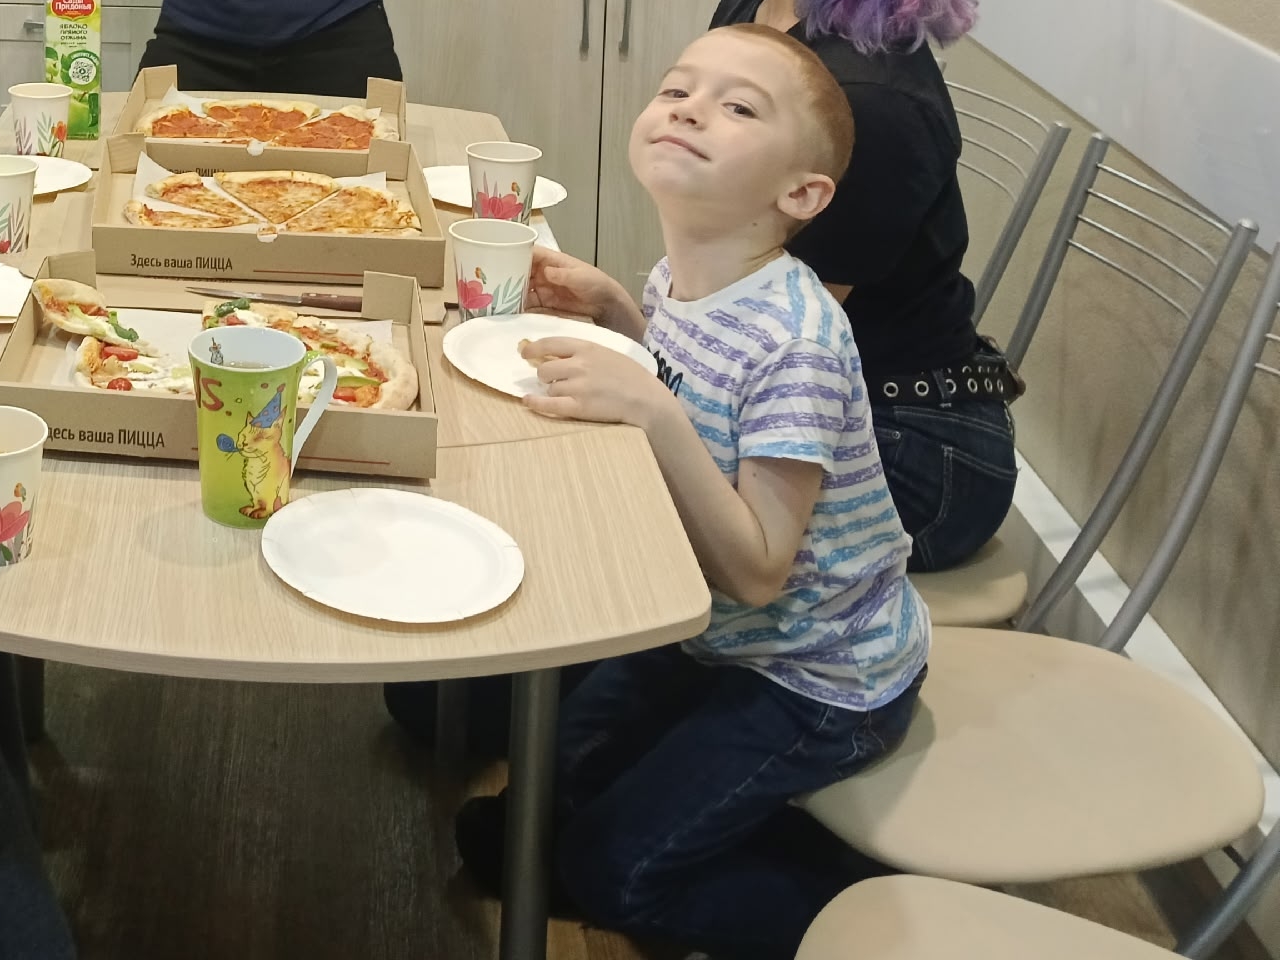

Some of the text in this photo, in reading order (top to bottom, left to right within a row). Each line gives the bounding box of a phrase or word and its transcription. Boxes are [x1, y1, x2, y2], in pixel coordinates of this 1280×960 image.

[55, 1, 92, 12] Придонья
[130, 253, 233, 272] Здесь ваша ПИЦЦА
[47, 426, 165, 449] десь ваша ПИЦЦА
